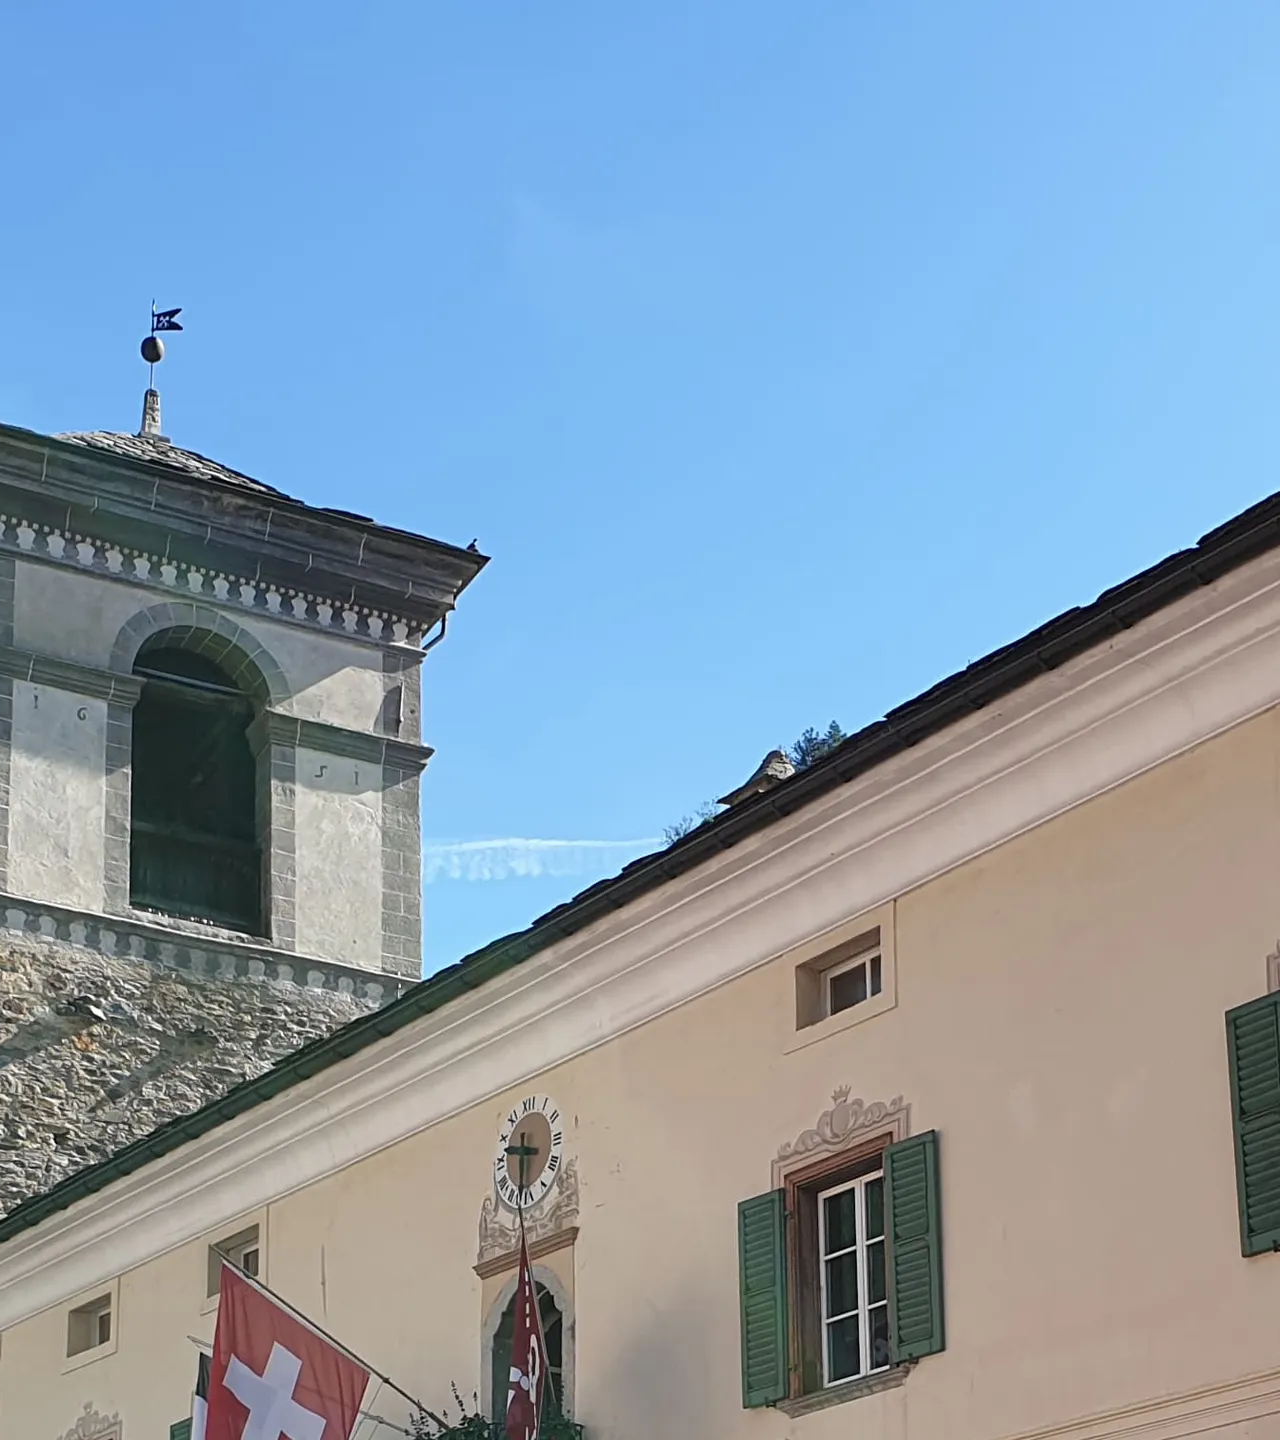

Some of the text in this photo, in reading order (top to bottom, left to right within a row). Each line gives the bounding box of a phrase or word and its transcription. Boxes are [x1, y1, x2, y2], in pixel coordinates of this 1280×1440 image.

[522, 1096, 536, 1114] XII
[508, 1110, 518, 1126] XI
[549, 1109, 559, 1124] II
[500, 1134, 509, 1143] X
[553, 1132, 562, 1146] III
